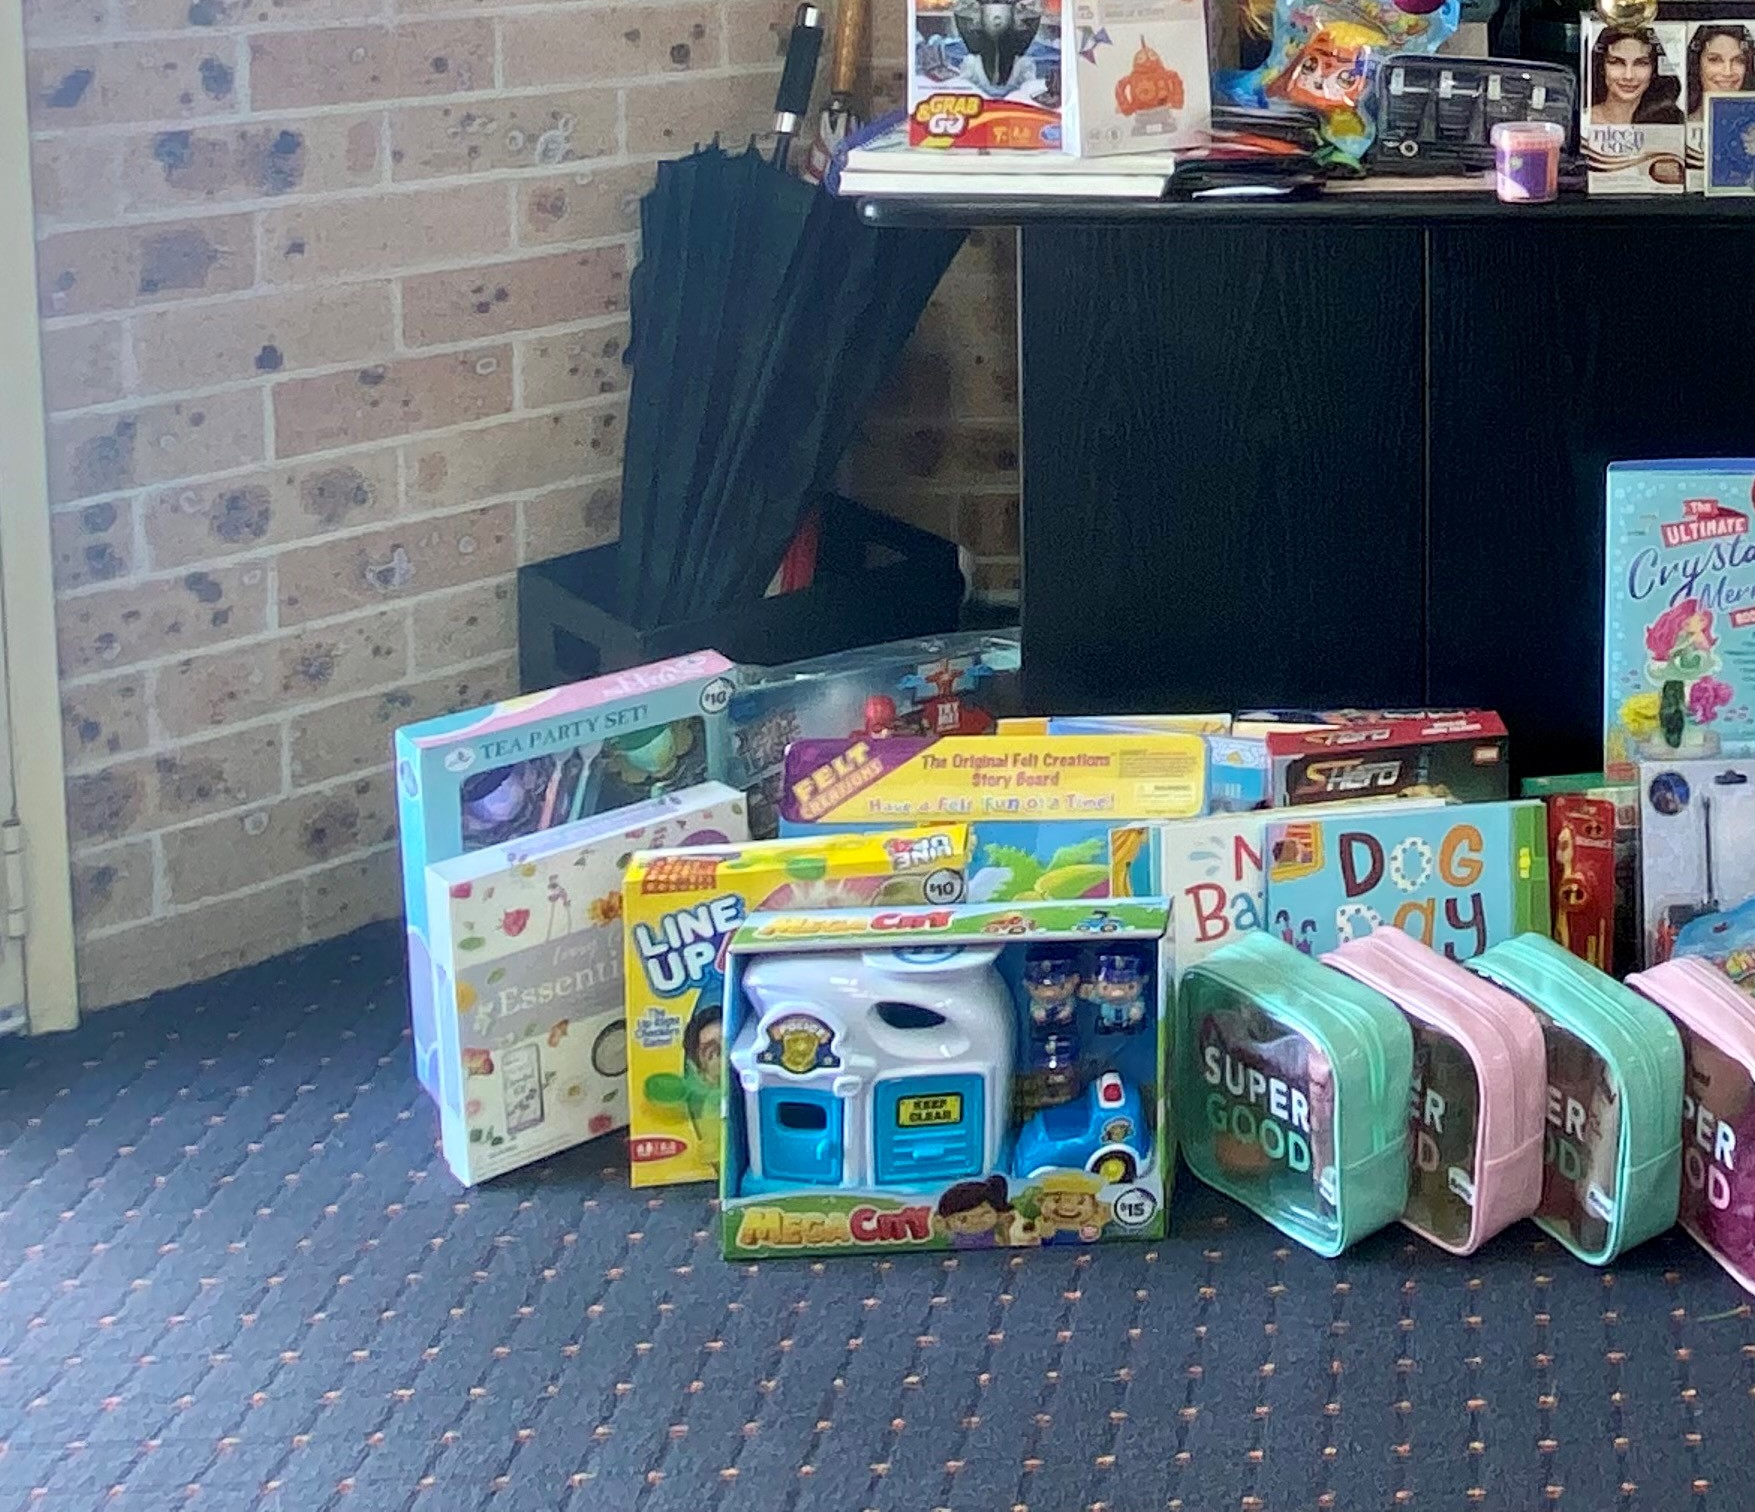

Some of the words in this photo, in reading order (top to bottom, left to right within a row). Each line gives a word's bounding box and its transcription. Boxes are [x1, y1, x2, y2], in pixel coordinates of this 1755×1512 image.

[929, 95, 980, 116] GRAB
[928, 113, 966, 135] GO
[1666, 518, 1747, 545] ULTIMATE
[705, 691, 727, 707] $10
[480, 740, 522, 760] TEA
[528, 716, 601, 749] PARTY
[792, 740, 871, 804] FELT
[921, 754, 947, 769] The
[952, 752, 1009, 770] Original
[1012, 752, 1039, 768] Felt
[1042, 751, 1111, 768] Creations
[801, 756, 884, 820] CREATIONS
[971, 771, 1011, 788] Story
[1015, 771, 1060, 787] Board
[868, 797, 911, 813] Have
[984, 795, 1020, 812] Fun
[1338, 823, 1485, 899] DOG
[929, 882, 955, 897] $10
[633, 894, 746, 958] LINE
[646, 946, 717, 994] UP
[499, 951, 620, 1018] Essenti
[779, 1020, 828, 1037] POLICE
[1204, 1045, 1312, 1133] SUPER
[908, 1110, 951, 1123] CLEAR
[913, 1100, 949, 1109] KEEP
[1206, 1092, 1312, 1174] GOOD
[1119, 1201, 1146, 1218] $15
[739, 1206, 851, 1245] MEGA
[849, 1206, 935, 1243] CITY
